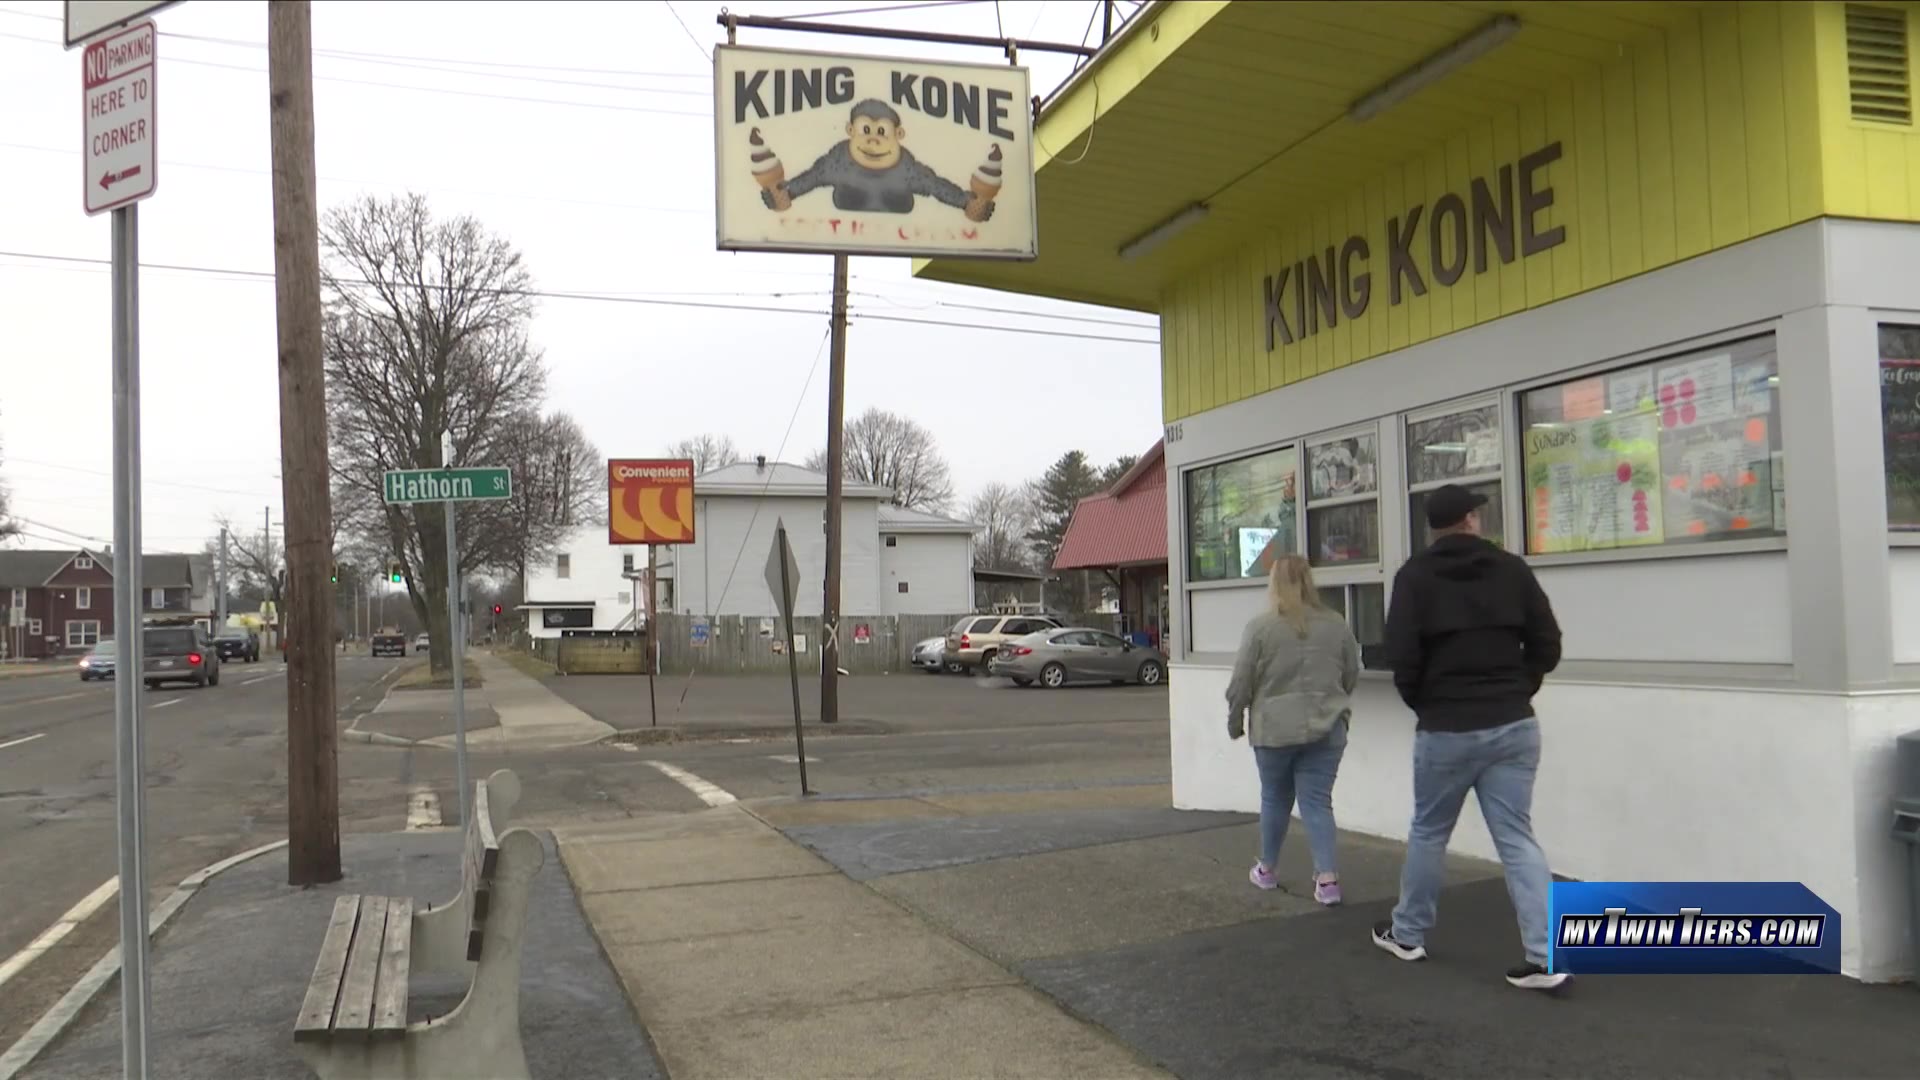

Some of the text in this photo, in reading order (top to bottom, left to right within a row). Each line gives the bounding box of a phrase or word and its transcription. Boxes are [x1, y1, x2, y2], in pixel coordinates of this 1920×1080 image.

[86, 34, 151, 84] NO PARKING
[91, 78, 148, 118] HERE TO
[735, 67, 1014, 141] KING KONE
[93, 119, 146, 157] CORNER
[1263, 141, 1566, 352] KING KONE
[1166, 423, 1183, 444] 1315
[392, 473, 505, 500] Hathorn St
[618, 465, 690, 478] Convenient
